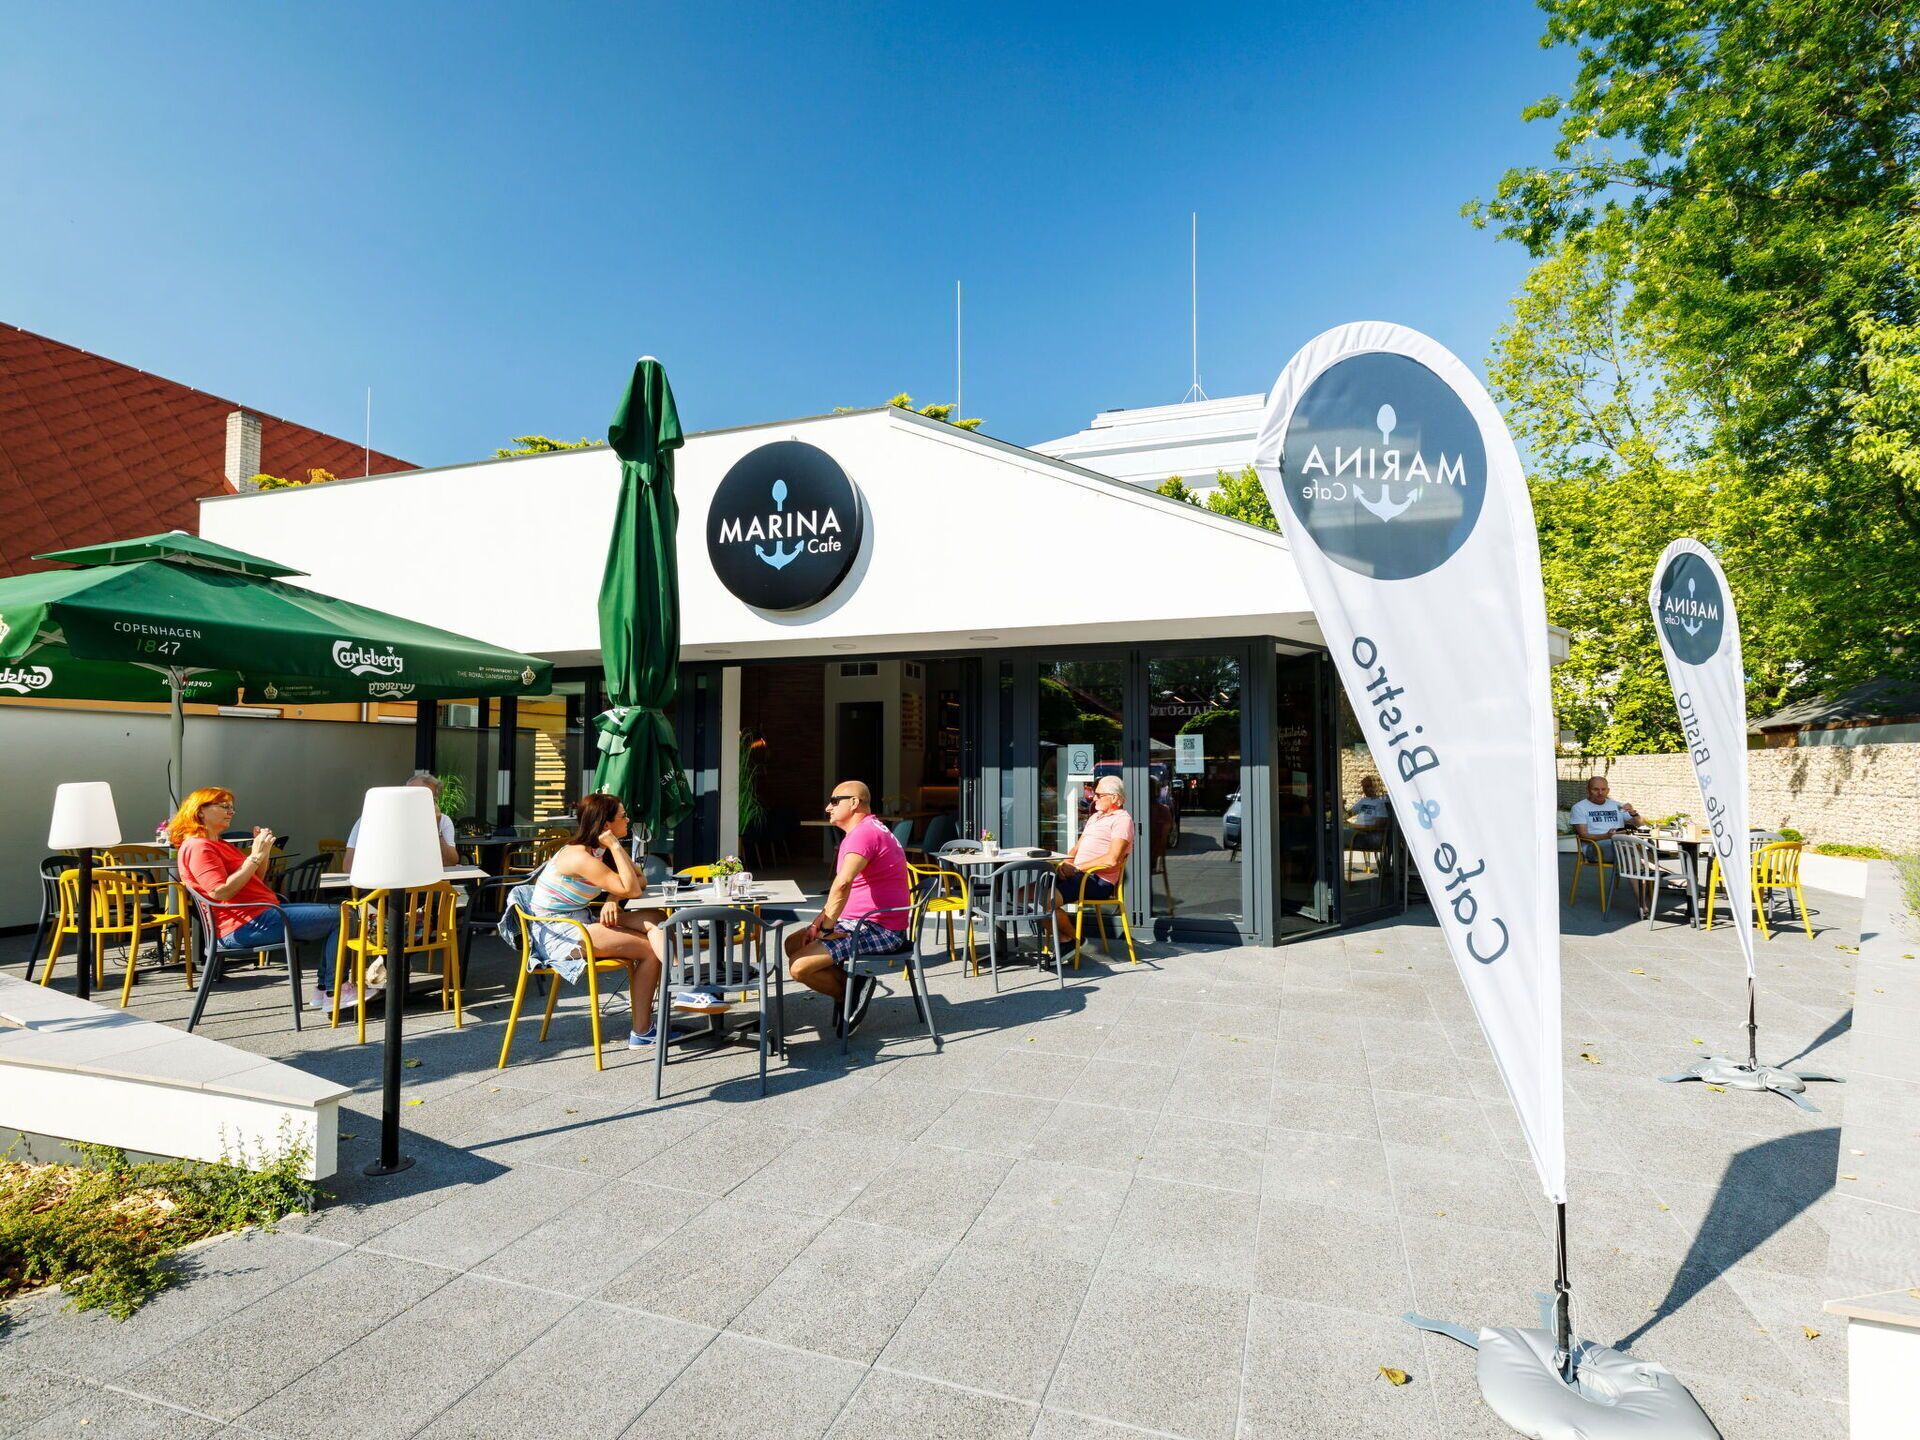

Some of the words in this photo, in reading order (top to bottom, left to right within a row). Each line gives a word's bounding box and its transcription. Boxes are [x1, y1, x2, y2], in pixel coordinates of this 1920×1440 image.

[718, 507, 842, 544] MARINA
[807, 536, 842, 553] Cafe
[113, 621, 201, 639] COPENHAGEN
[137, 639, 181, 655] 1847
[332, 640, 403, 675] Carlsberg
[468, 671, 485, 679] ROYAL
